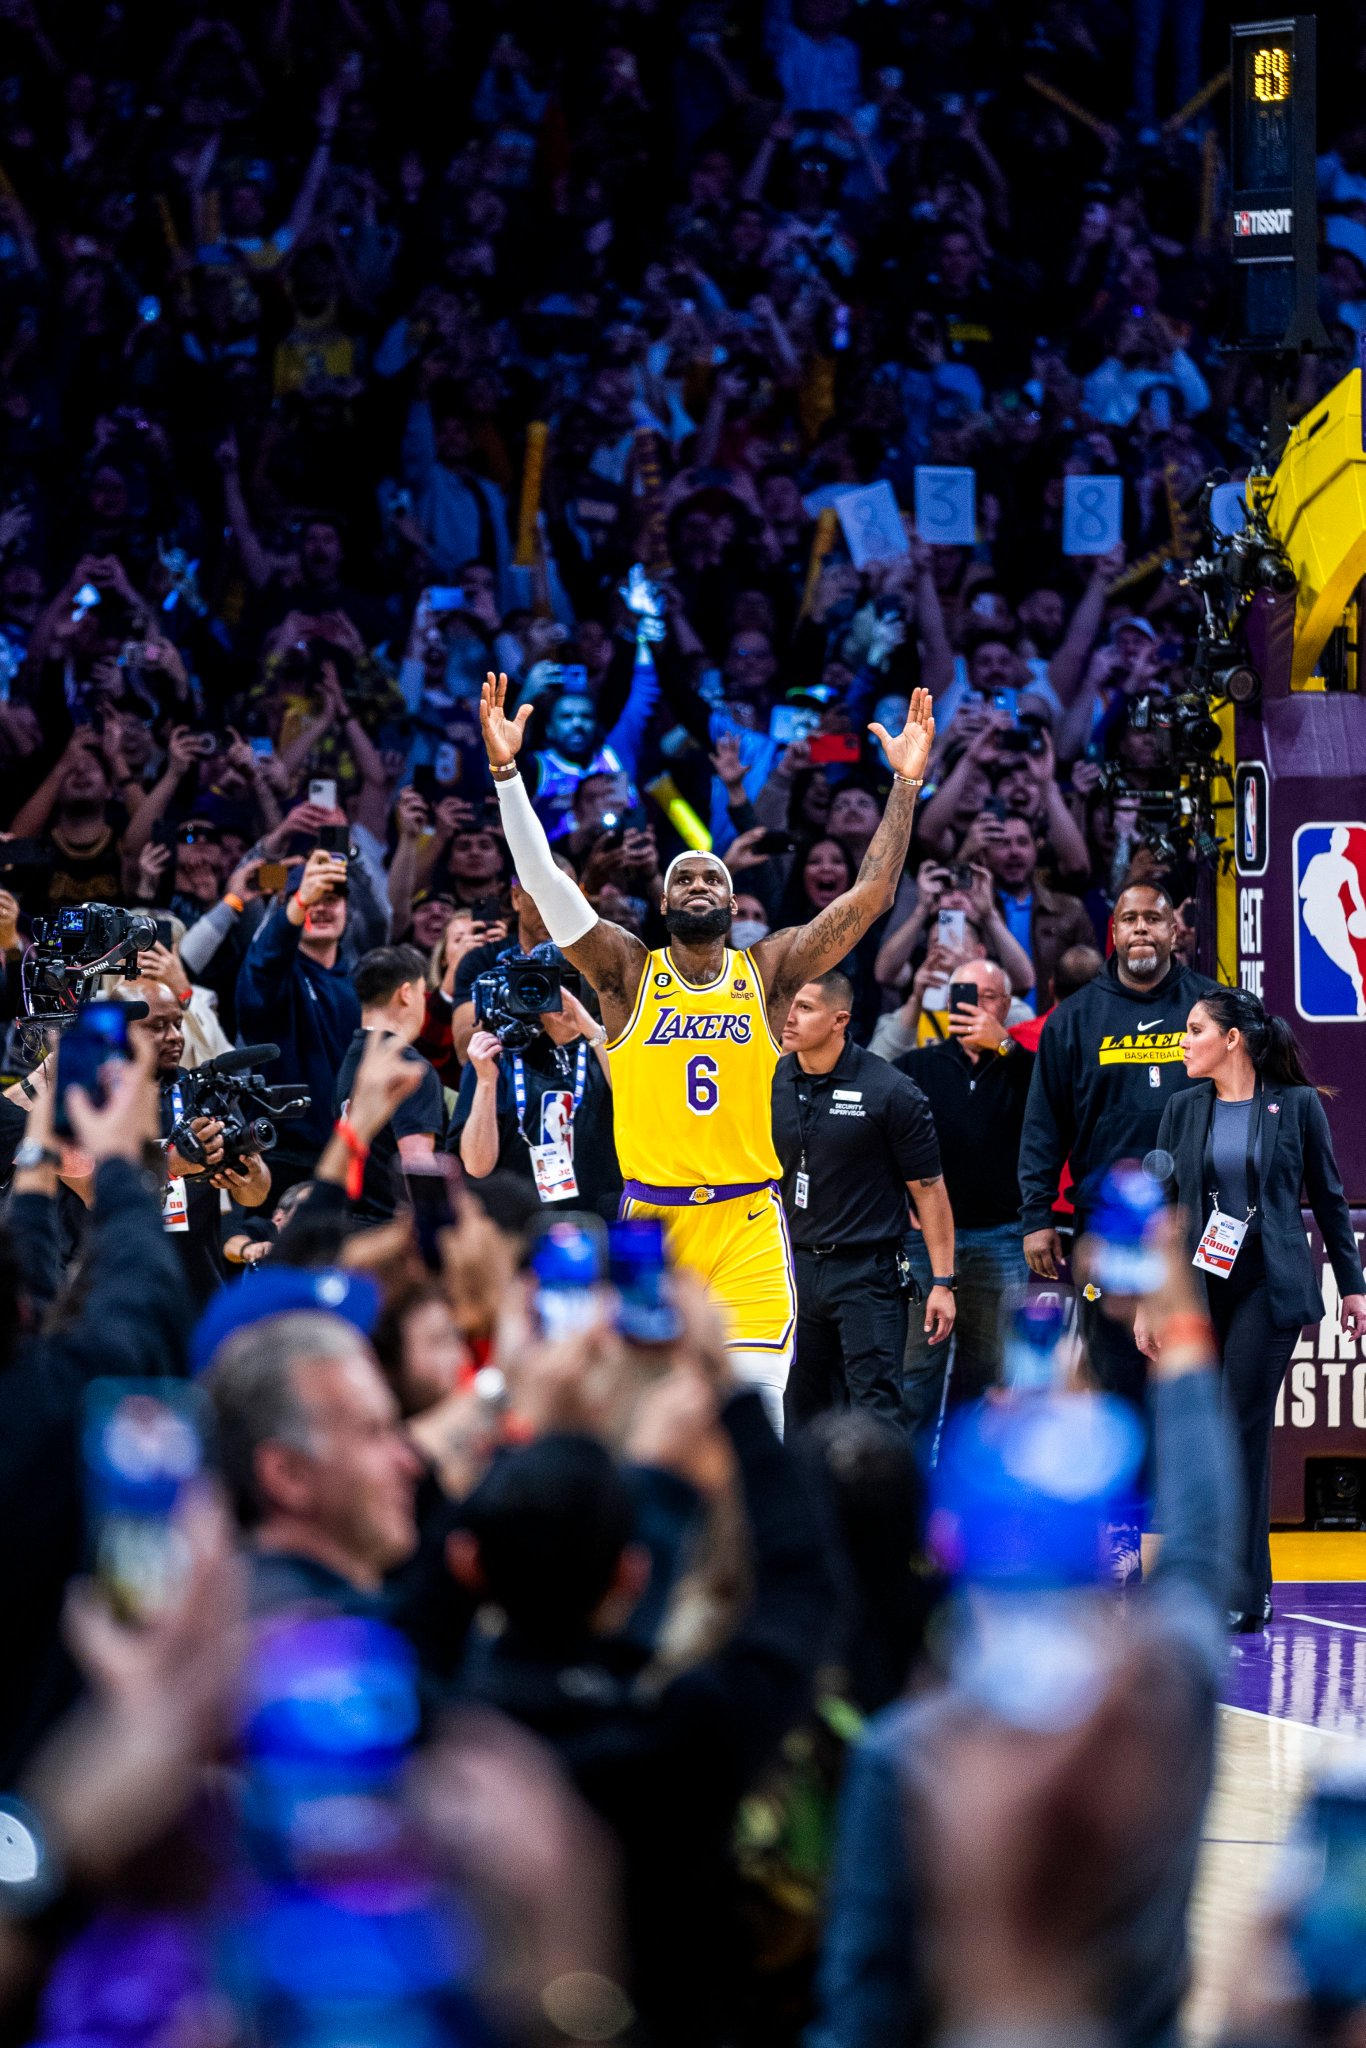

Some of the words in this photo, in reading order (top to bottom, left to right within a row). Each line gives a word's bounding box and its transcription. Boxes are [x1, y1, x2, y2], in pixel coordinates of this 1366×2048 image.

[1249, 208, 1293, 235] TISSOT
[928, 474, 959, 527] 3
[1077, 485, 1109, 543] 8
[1240, 888, 1263, 954] GET
[83, 961, 110, 977] RONIN
[657, 974, 670, 986] 6
[730, 991, 755, 1001] bibigo
[644, 1007, 752, 1046] LAKERS
[1099, 1032, 1189, 1050] LAKER
[1124, 1050, 1182, 1060] BASKETBALL
[686, 1054, 719, 1116] 6
[829, 1108, 866, 1117] SUPERVISOR
[835, 1102, 863, 1111] SECURITY
